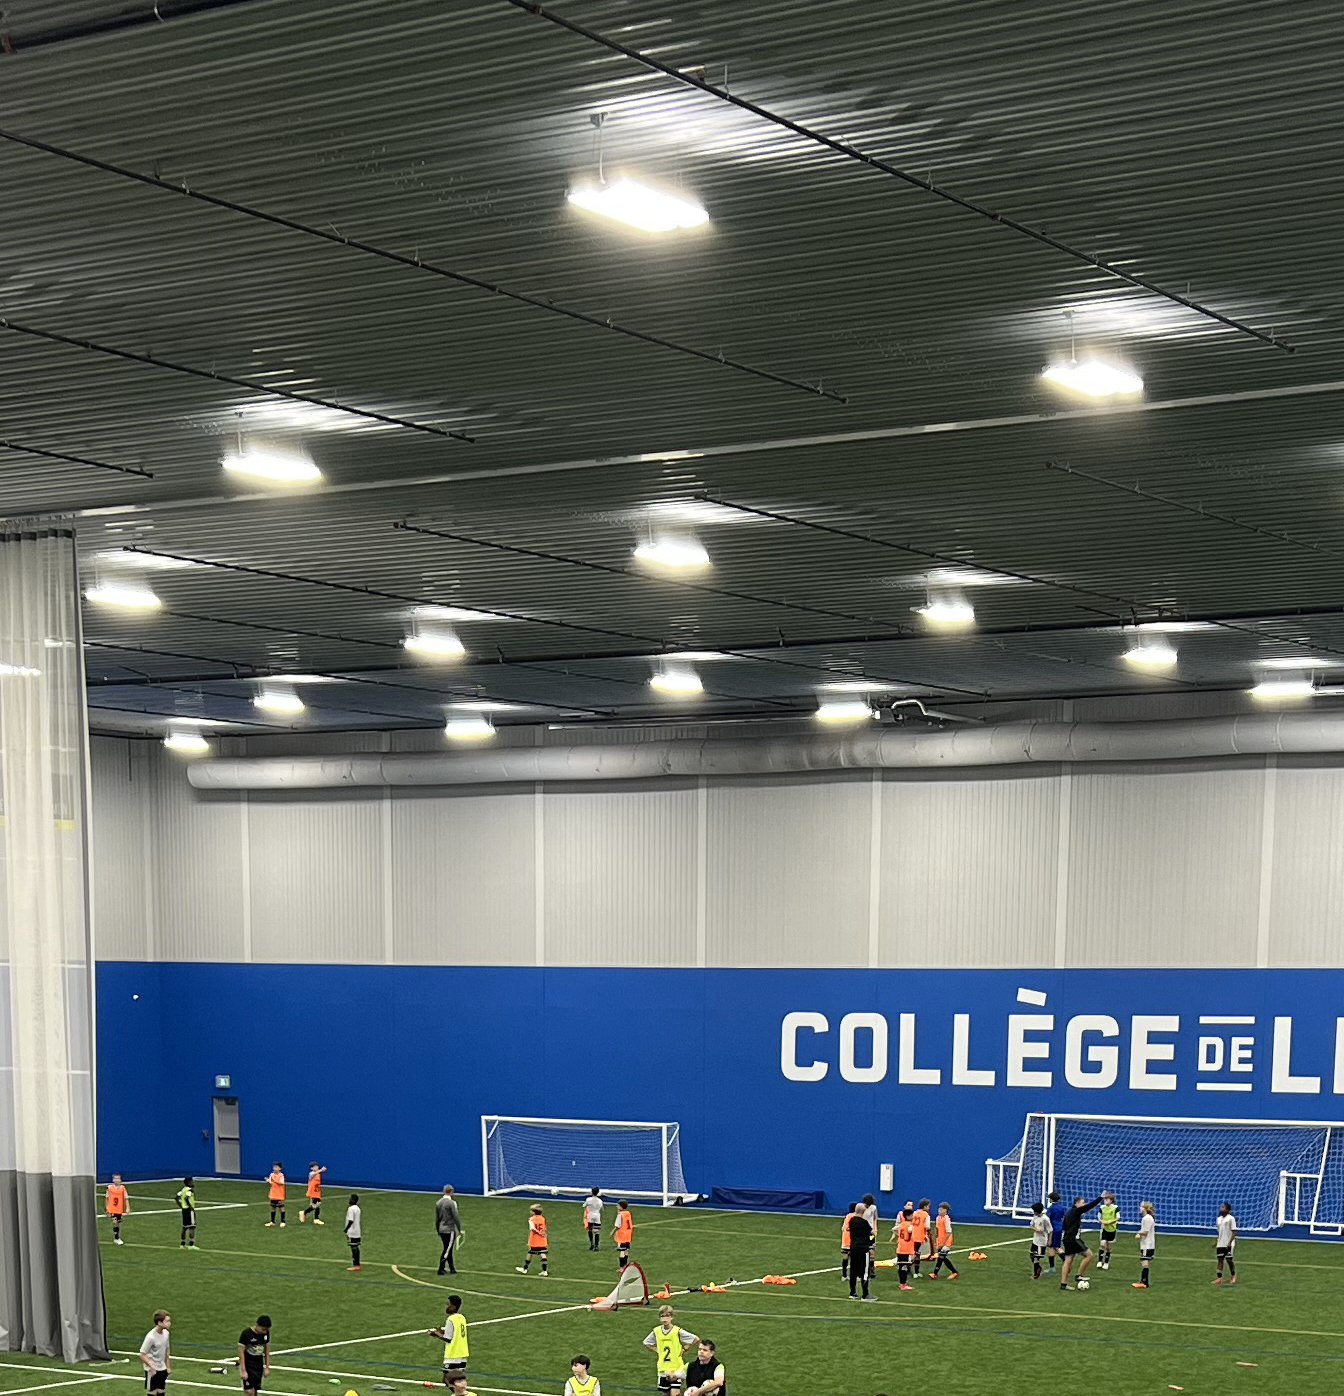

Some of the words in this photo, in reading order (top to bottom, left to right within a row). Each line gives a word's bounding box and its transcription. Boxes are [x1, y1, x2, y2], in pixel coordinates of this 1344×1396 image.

[780, 987, 1180, 1091] COLLÈGE
[1201, 1035, 1255, 1073] DE
[663, 1346, 671, 1362] 2
